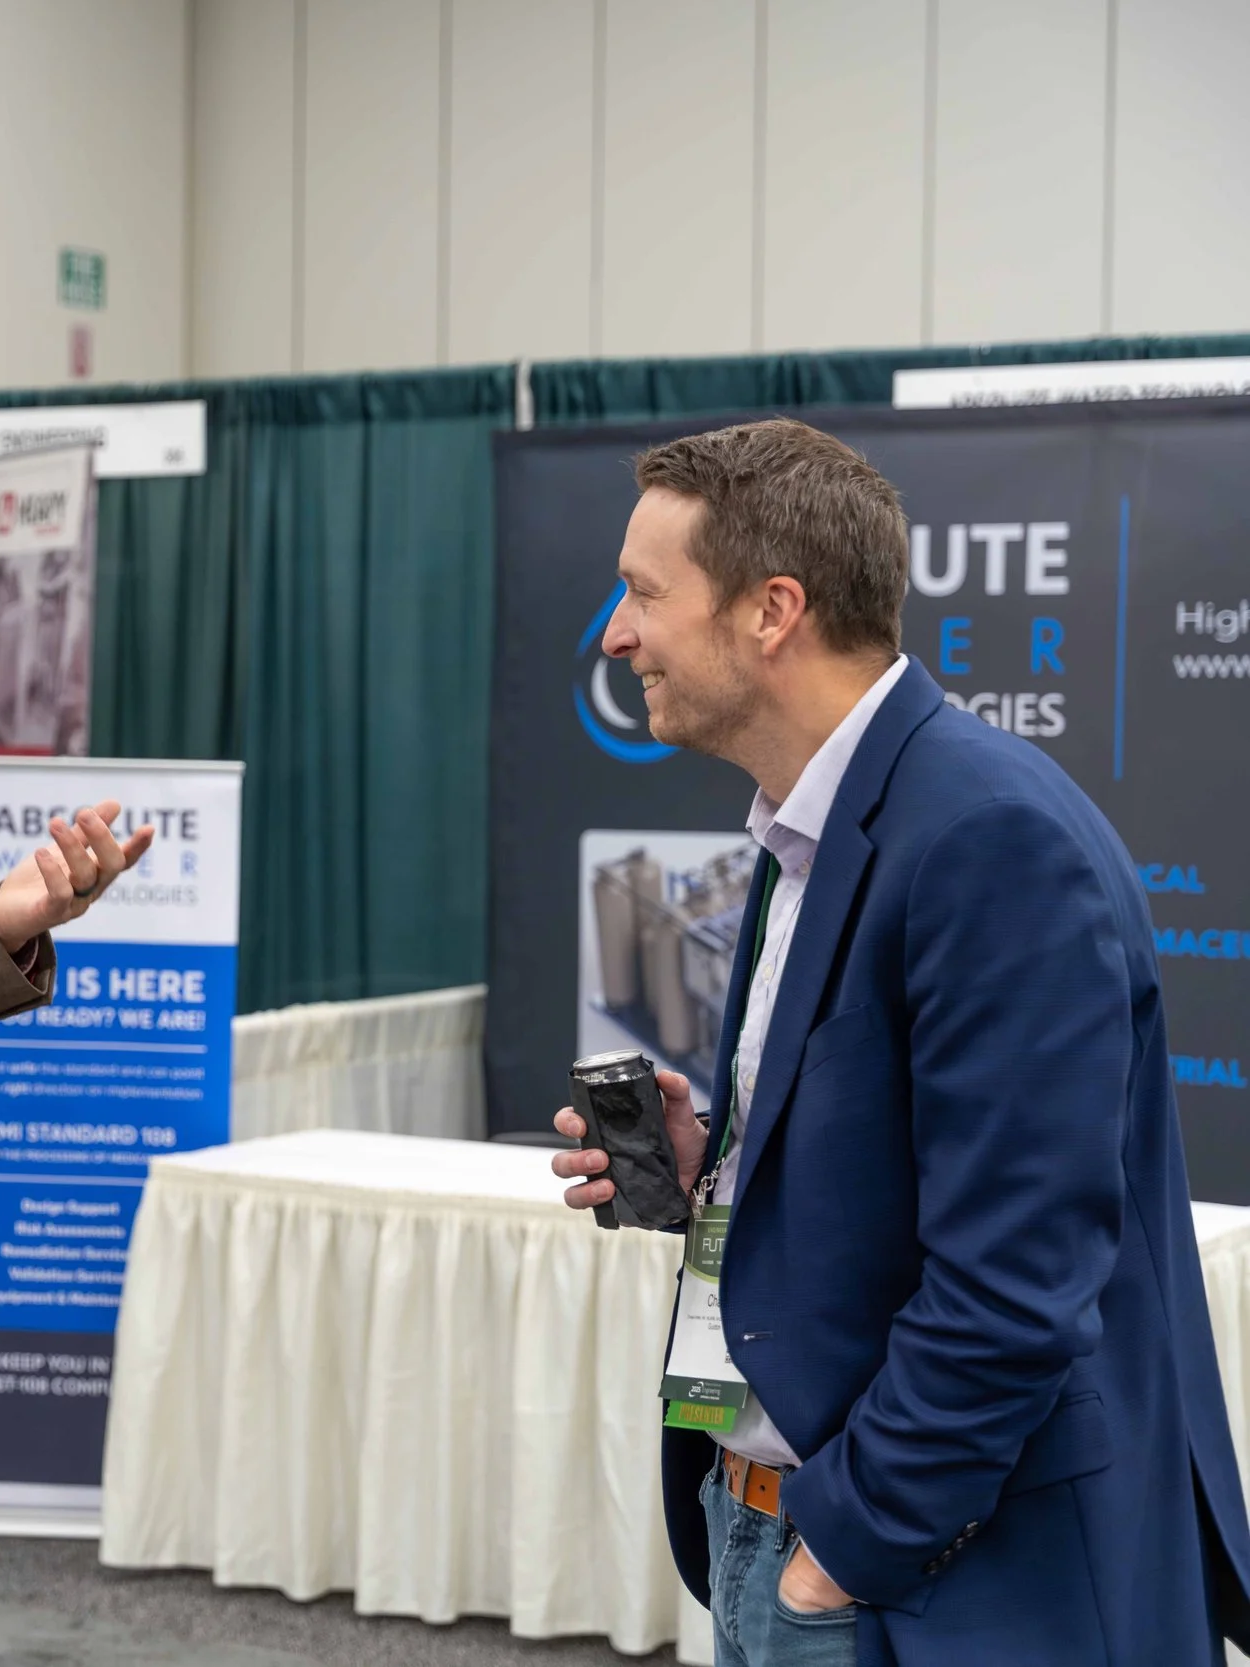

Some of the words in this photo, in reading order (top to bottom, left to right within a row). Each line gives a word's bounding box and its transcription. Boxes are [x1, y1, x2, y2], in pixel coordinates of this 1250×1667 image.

[944, 692, 1066, 737] GIES
[65, 966, 100, 1001] IS
[108, 967, 206, 1004] HERE
[118, 1007, 154, 1030] WE
[26, 1121, 138, 1146] STANDARD
[47, 1353, 87, 1375] YOU
[679, 1402, 725, 1425] PRESENTER
